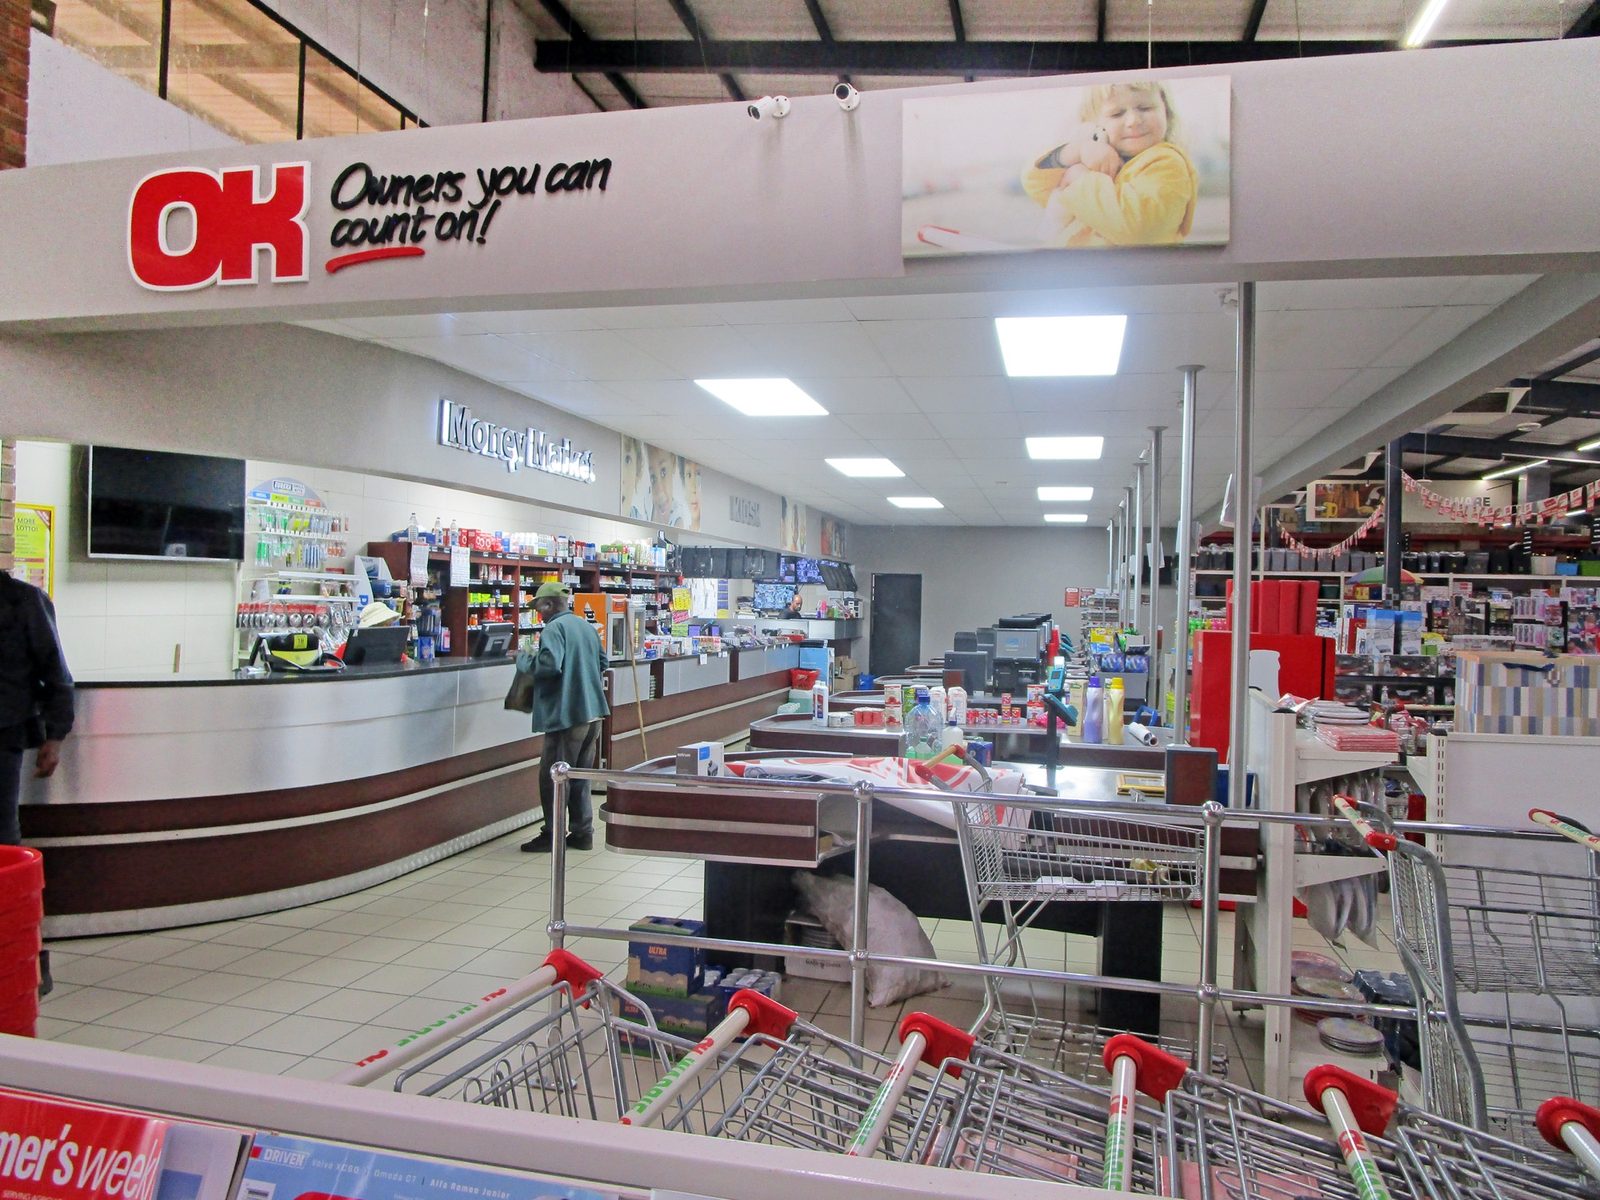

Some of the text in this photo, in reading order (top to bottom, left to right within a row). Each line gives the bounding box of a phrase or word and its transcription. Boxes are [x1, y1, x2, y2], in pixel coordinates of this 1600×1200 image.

[330, 157, 612, 211] Owners you can
[128, 161, 310, 291] OK
[330, 199, 501, 248] count on!
[440, 399, 596, 484] Money Market
[648, 945, 667, 955] ULTRA
[263, 1148, 306, 1167] DRIVEN
[429, 1178, 448, 1189] Alfa
[450, 1182, 479, 1194] Romeo
[481, 1187, 511, 1199] Junior
